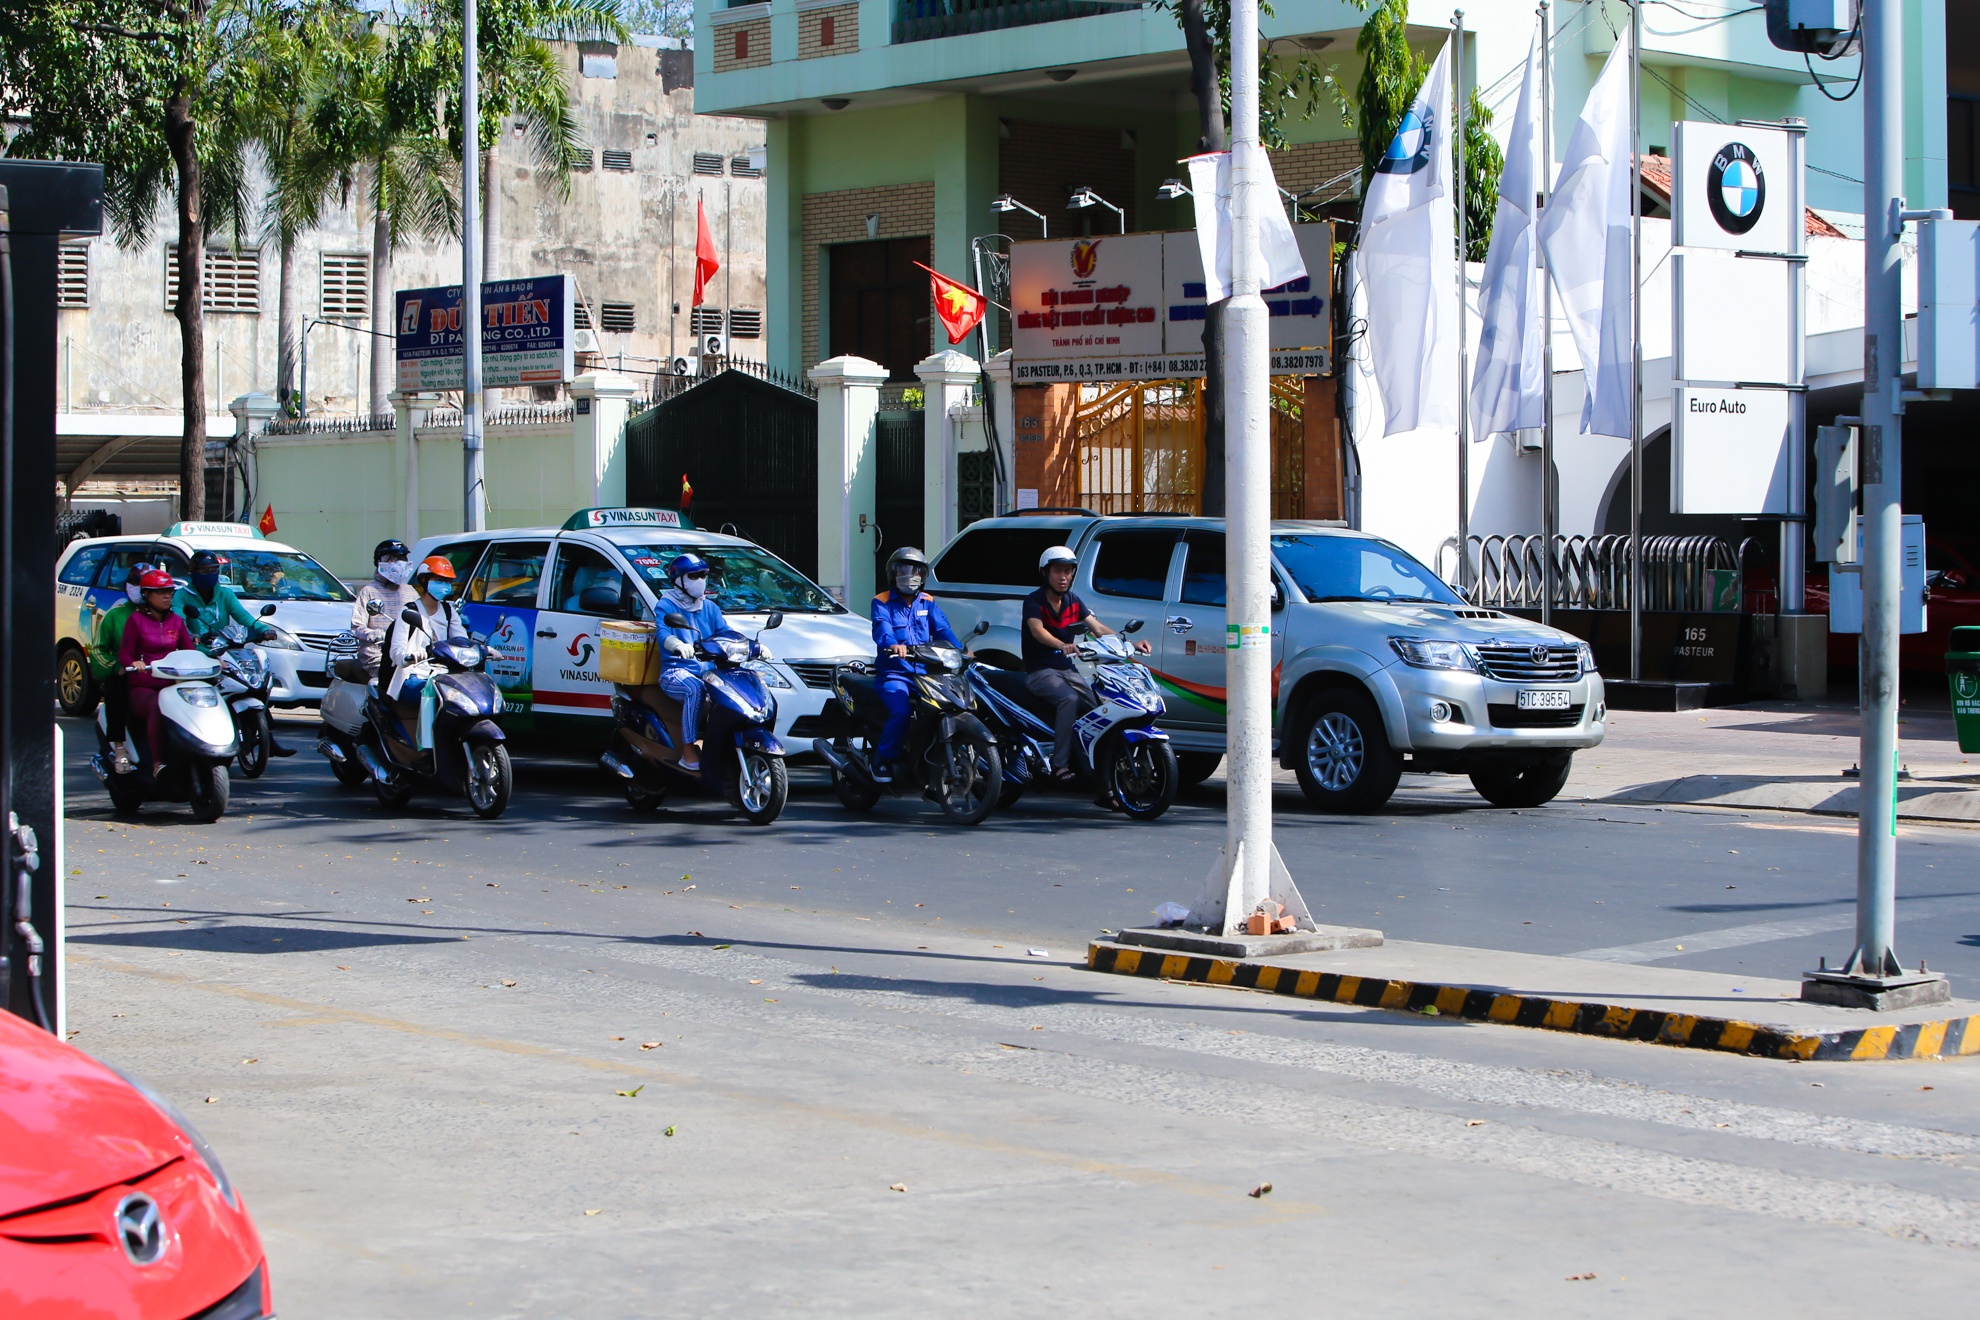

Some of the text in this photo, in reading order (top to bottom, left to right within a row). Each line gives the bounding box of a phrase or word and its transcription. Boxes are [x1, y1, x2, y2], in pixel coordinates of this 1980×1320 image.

[1695, 144, 1762, 175] BMW
[447, 288, 461, 298] CTY
[484, 286, 492, 294] IN
[504, 284, 510, 292] &
[512, 282, 526, 292] BAO
[430, 292, 550, 332] ĐỨ TIẾN
[430, 333, 445, 344] ĐT
[1106, 336, 1120, 344] MINH
[1271, 355, 1324, 369] 08.3820 7978
[1017, 367, 1029, 378] 163
[1031, 366, 1062, 379] PASTEUR,
[1095, 362, 1122, 376] TP.HCM
[1145, 361, 1166, 375] (+84)
[1169, 360, 1198, 374] 08.3820
[1690, 398, 1746, 414] Euro Auto
[1021, 417, 1038, 428] 163
[1685, 628, 1706, 641] 165
[1674, 646, 1714, 656] PASTEUR
[560, 669, 600, 683] VINASUN
[1520, 692, 1568, 707] 51C-395.54
[514, 704, 524, 713] 27
